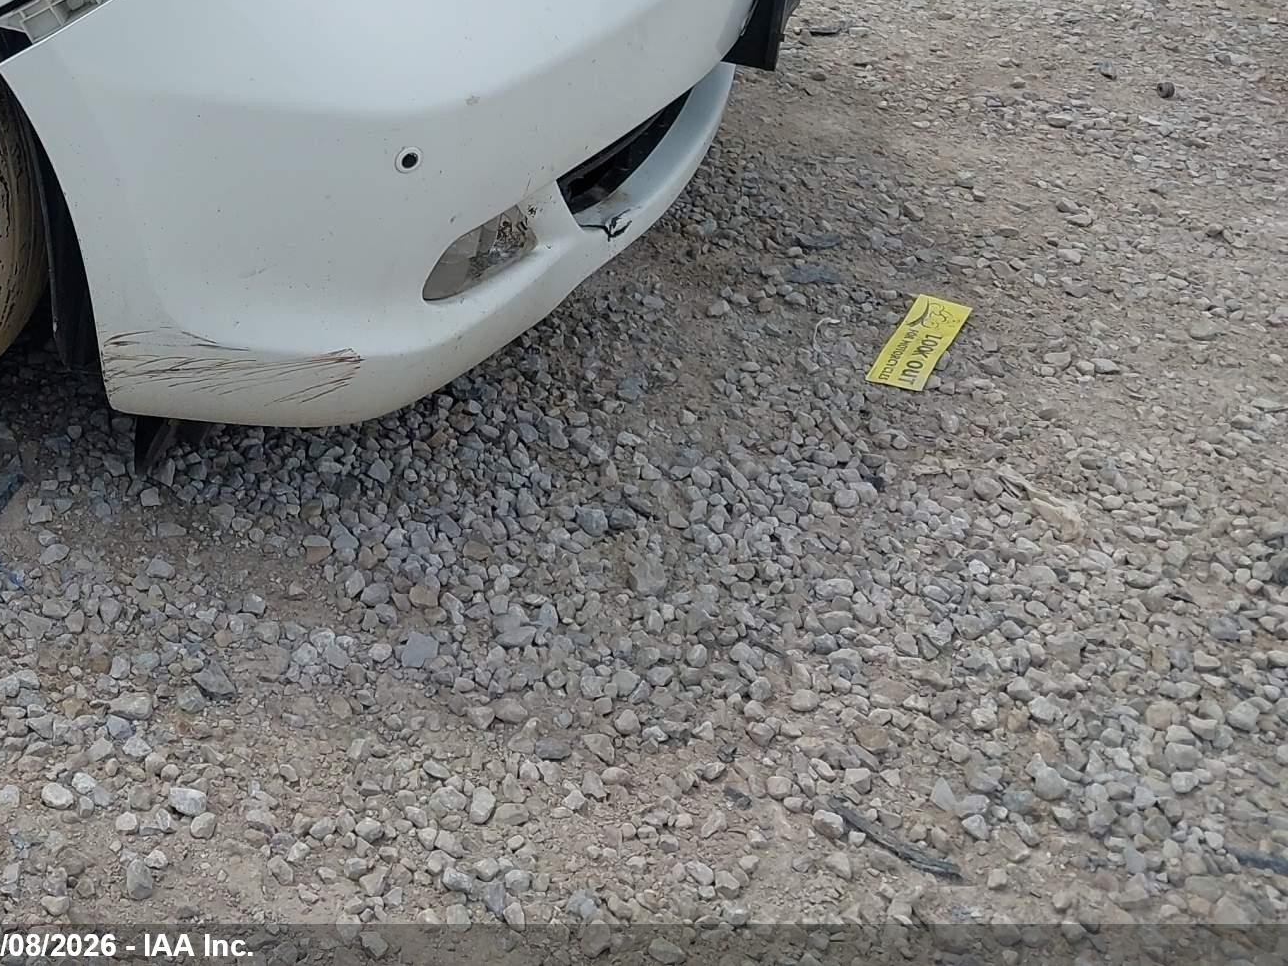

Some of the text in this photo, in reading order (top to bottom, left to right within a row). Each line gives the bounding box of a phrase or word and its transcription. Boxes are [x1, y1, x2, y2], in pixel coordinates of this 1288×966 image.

[878, 329, 919, 381] FOR MOTORCYCLES
[898, 334, 944, 385] LOOK OUT
